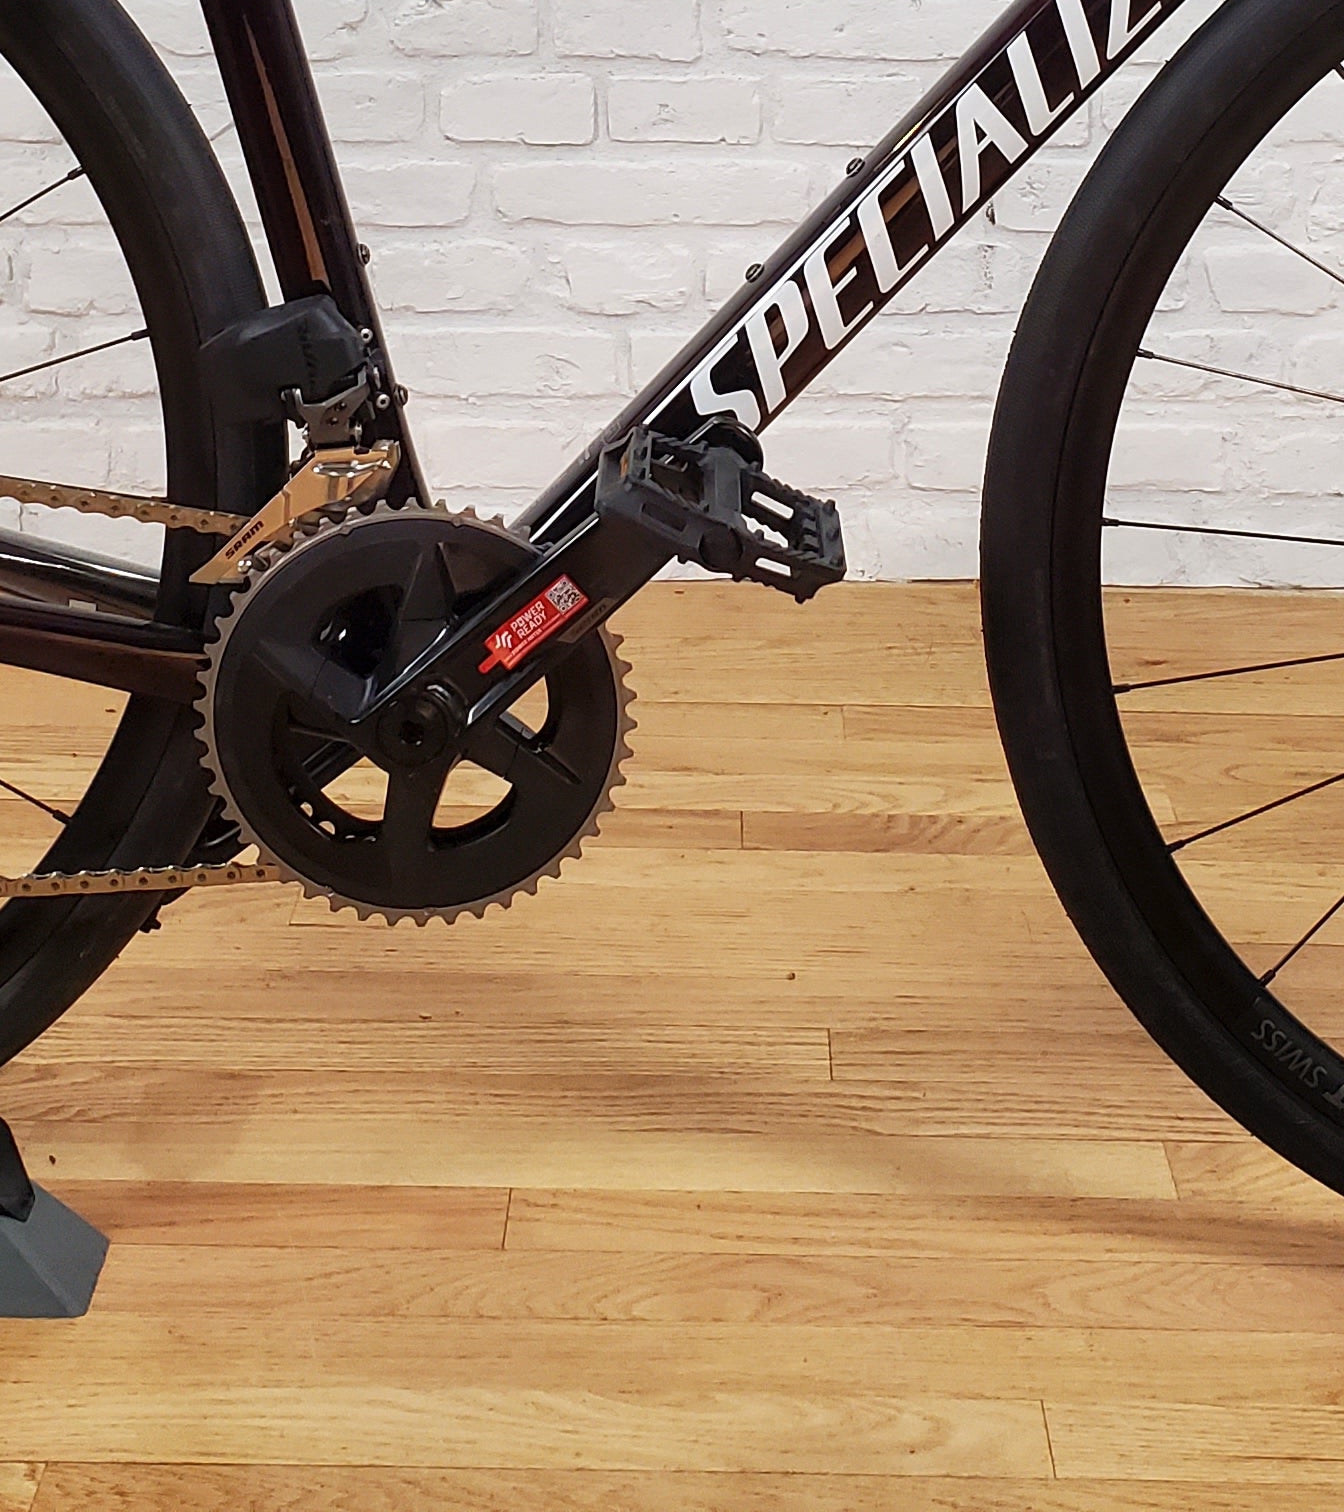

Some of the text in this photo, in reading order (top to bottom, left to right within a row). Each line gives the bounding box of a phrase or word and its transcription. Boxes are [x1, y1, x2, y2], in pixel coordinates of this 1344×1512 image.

[225, 520, 264, 560] SRAM
[510, 600, 545, 633] POWER
[516, 609, 548, 639] READY
[1251, 1019, 1328, 1088] SWISS
